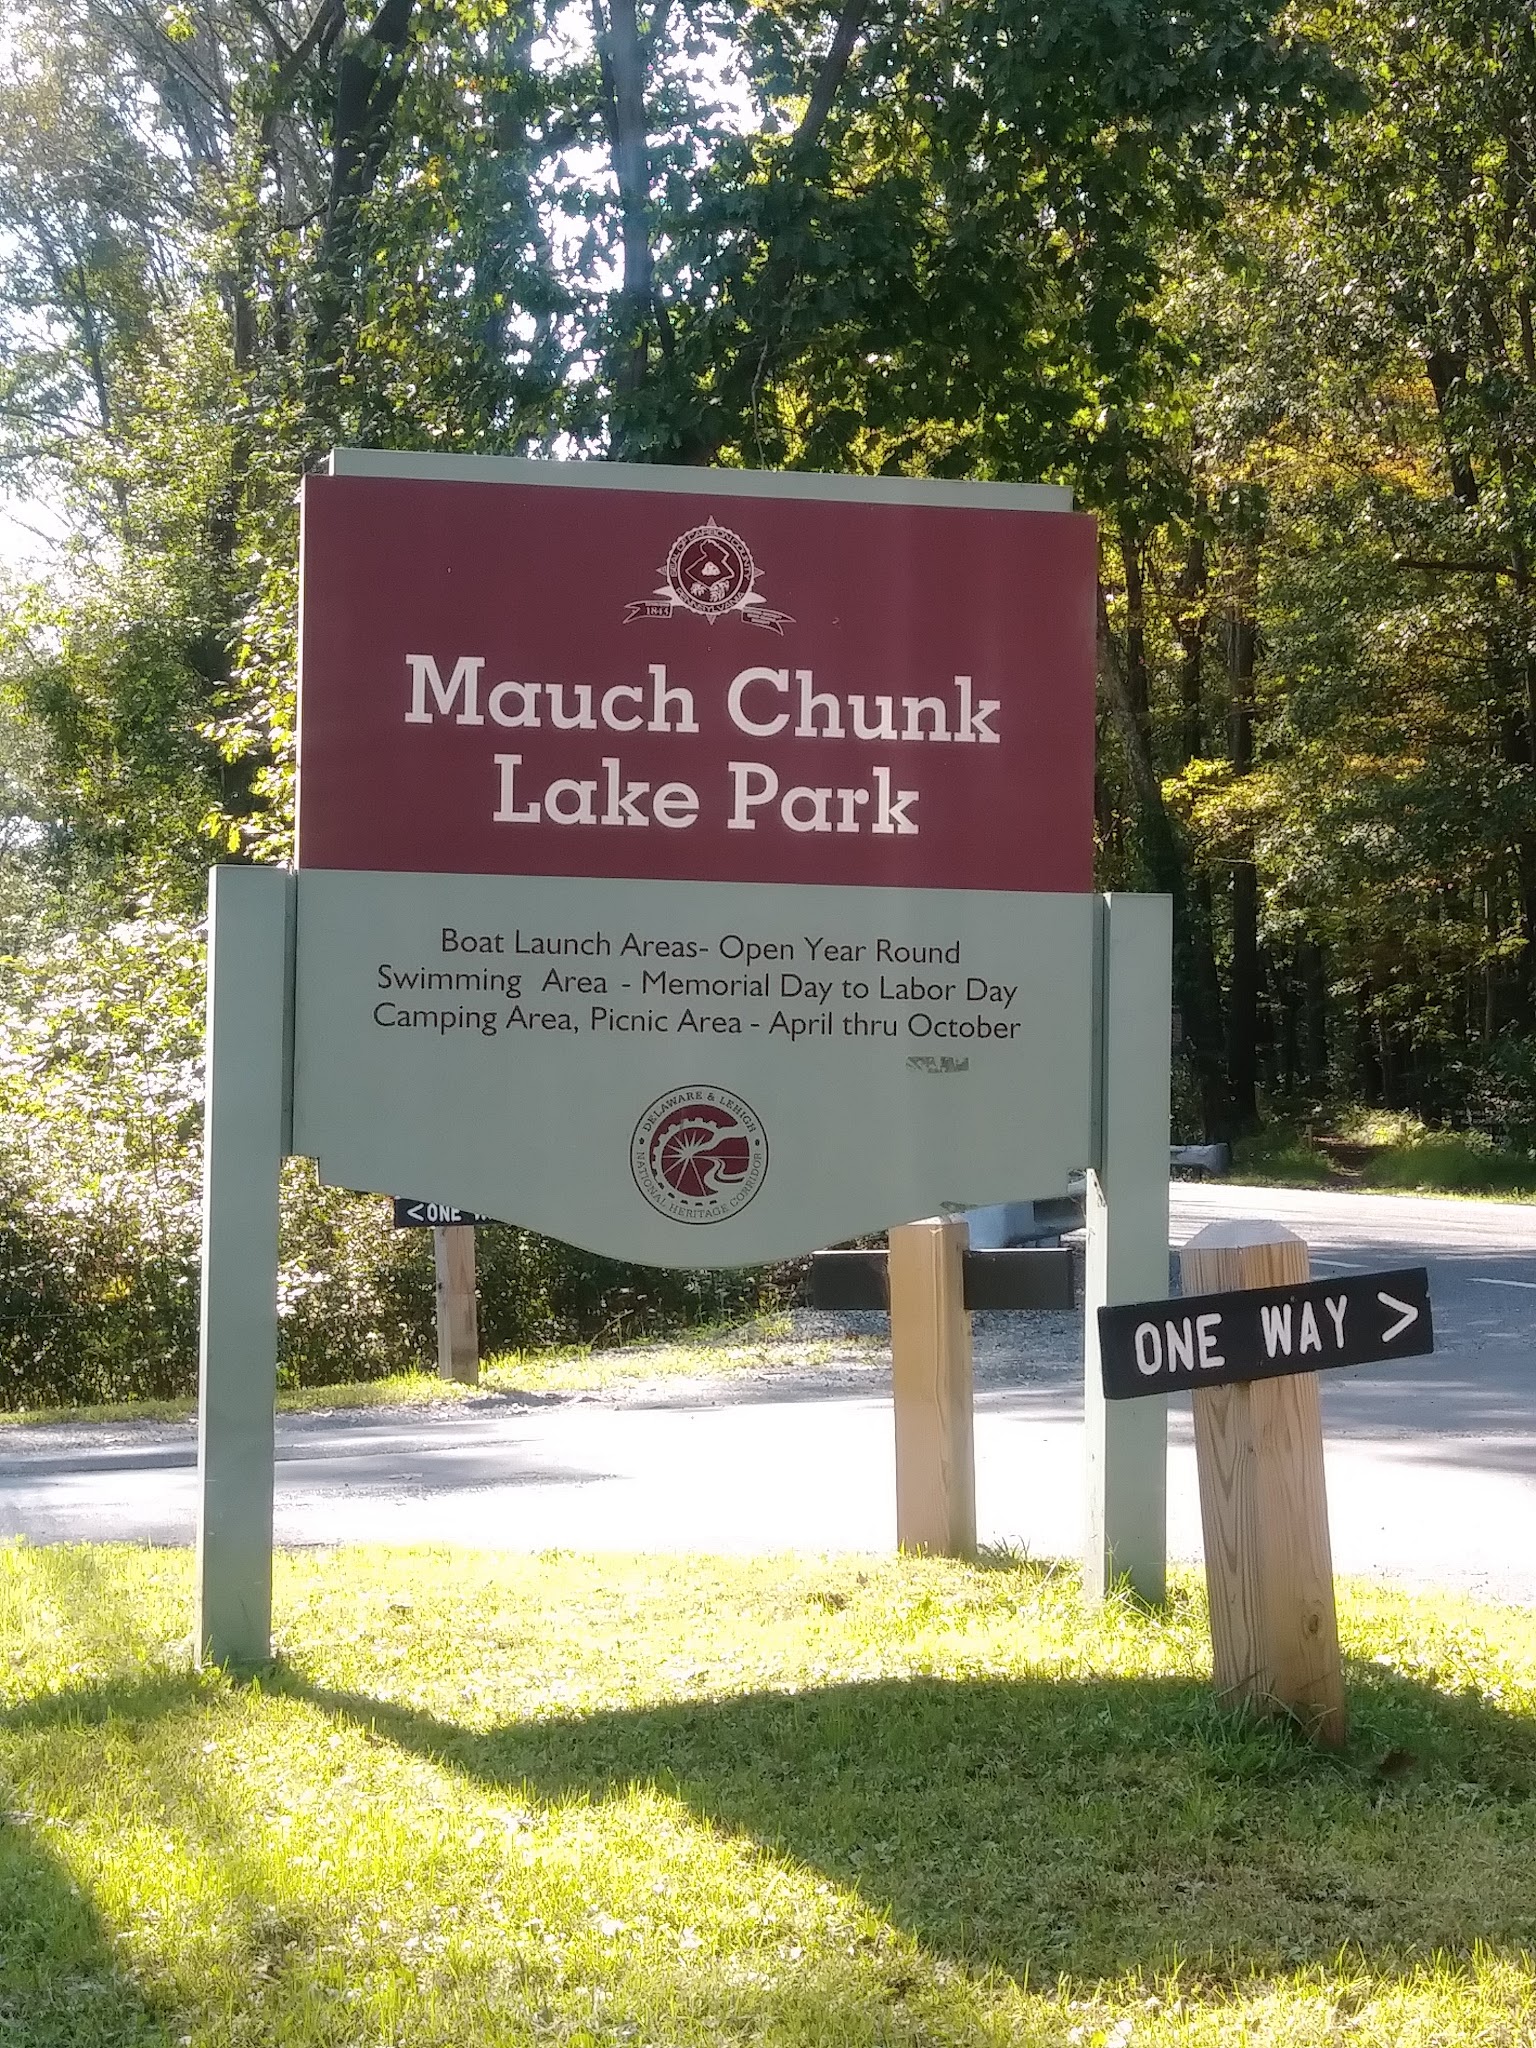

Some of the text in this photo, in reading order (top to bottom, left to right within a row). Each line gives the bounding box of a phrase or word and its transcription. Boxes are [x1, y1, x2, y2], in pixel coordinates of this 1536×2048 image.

[676, 538, 689, 550] OF
[687, 528, 731, 543] CARBON
[730, 537, 751, 581] COUNTY
[675, 587, 745, 612] PENNSYLVANIA
[404, 653, 1001, 743] Mauch Chunk
[493, 754, 920, 835] Lake Park
[441, 928, 960, 966] Boat Launch Areas- Open Year Round
[378, 964, 521, 999] Swimming
[541, 968, 607, 995] Area
[642, 970, 769, 997] Memorial
[781, 973, 833, 1005] Day
[843, 979, 869, 999] to
[880, 975, 956, 1002] Labor
[967, 978, 1018, 1009] Day
[373, 1002, 497, 1037] Camping
[506, 1005, 579, 1034] Area,
[592, 1006, 668, 1033] Picnic
[677, 1008, 742, 1034] Area
[769, 1010, 833, 1042] April
[843, 1012, 897, 1037] thru
[908, 1013, 1022, 1039] October
[642, 1091, 757, 1133] DELAWARE & LEHIGH
[636, 1152, 762, 1219] NATIONAL HERITAGE CORRIDOR
[1134, 1294, 1349, 1376] ONE WAY
